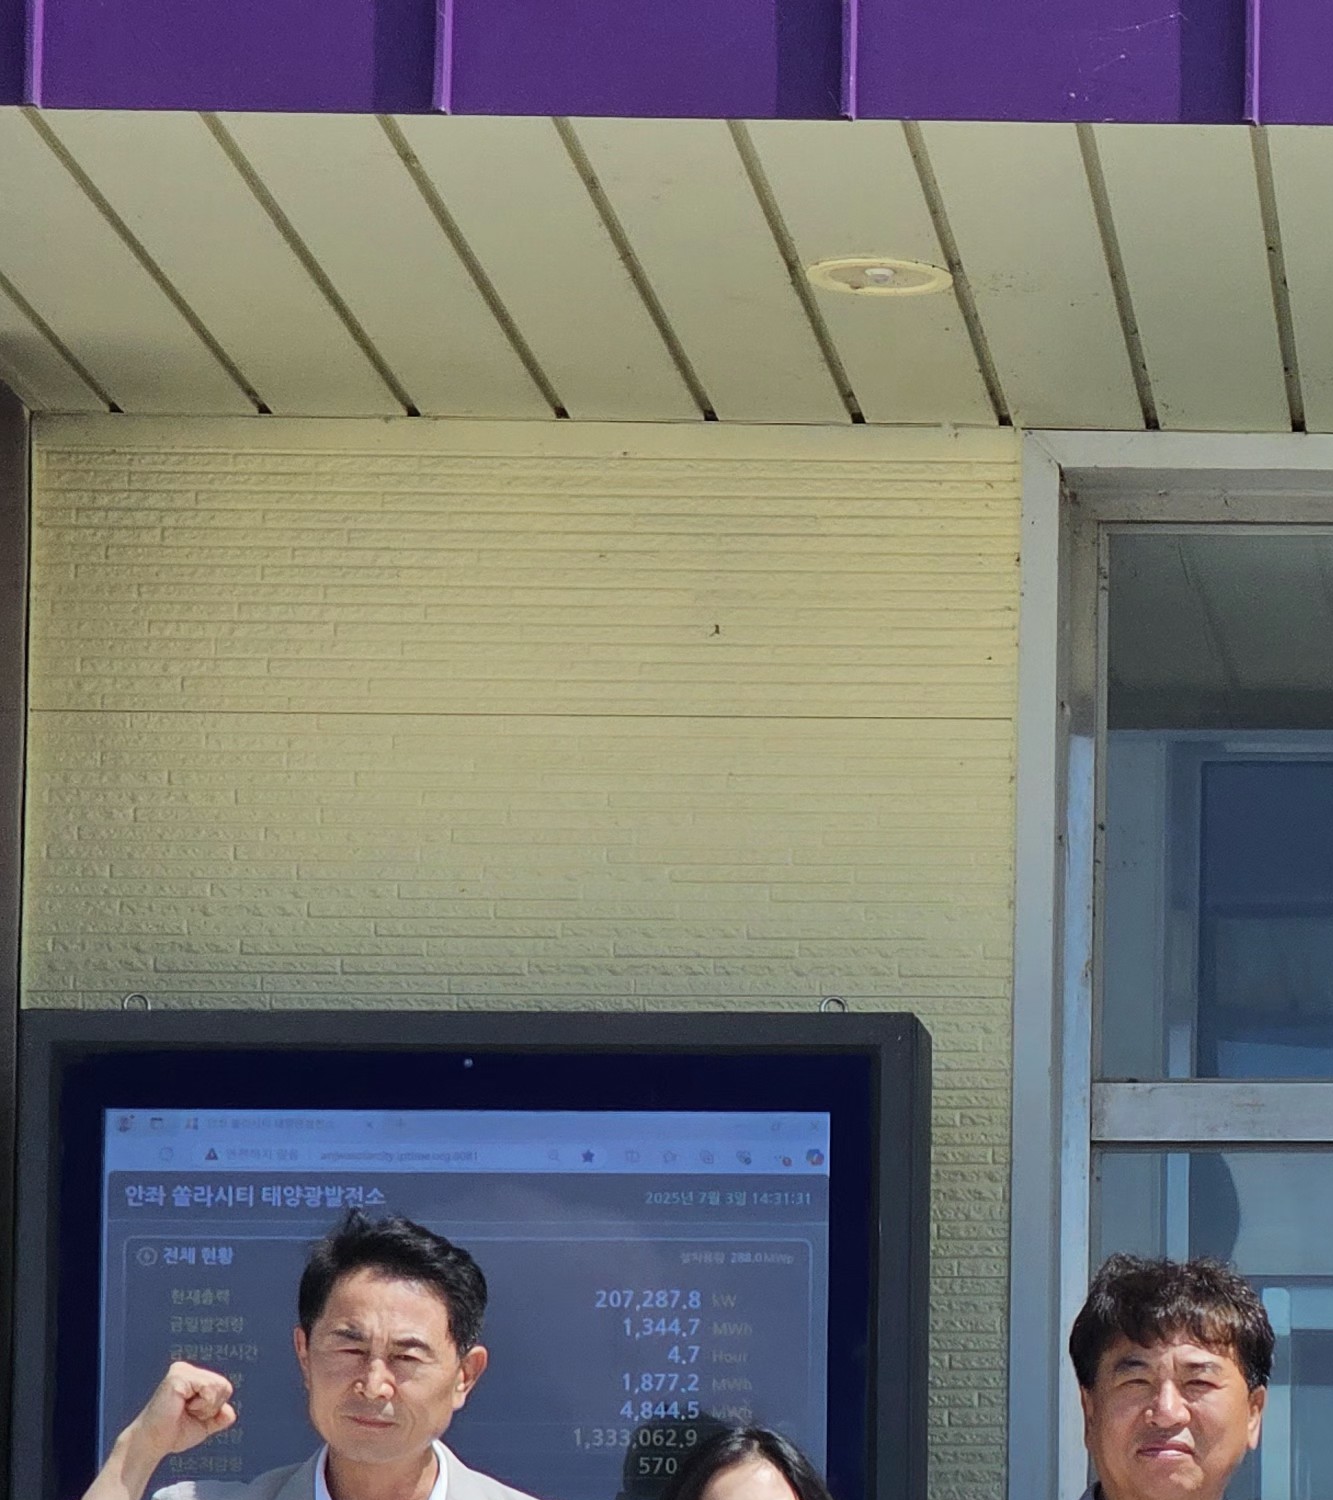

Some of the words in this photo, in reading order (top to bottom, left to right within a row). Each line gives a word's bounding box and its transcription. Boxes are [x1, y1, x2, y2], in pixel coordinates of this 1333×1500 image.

[125, 1184, 166, 1208] 안좌
[172, 1184, 254, 1208] 쏠라시티
[261, 1184, 387, 1209] 태양광발전소
[645, 1191, 694, 1206] 2025년
[699, 1191, 721, 1206] 7월
[726, 1191, 747, 1206] 3일
[595, 1289, 701, 1311] 207,287.8
[623, 1317, 700, 1340] 1,344.7
[667, 1345, 700, 1365] 4.7
[622, 1372, 700, 1395] 1,877.2
[620, 1401, 700, 1422] 4,844.5
[573, 1428, 698, 1449] 1,333,062.9
[638, 1456, 678, 1474] 570
